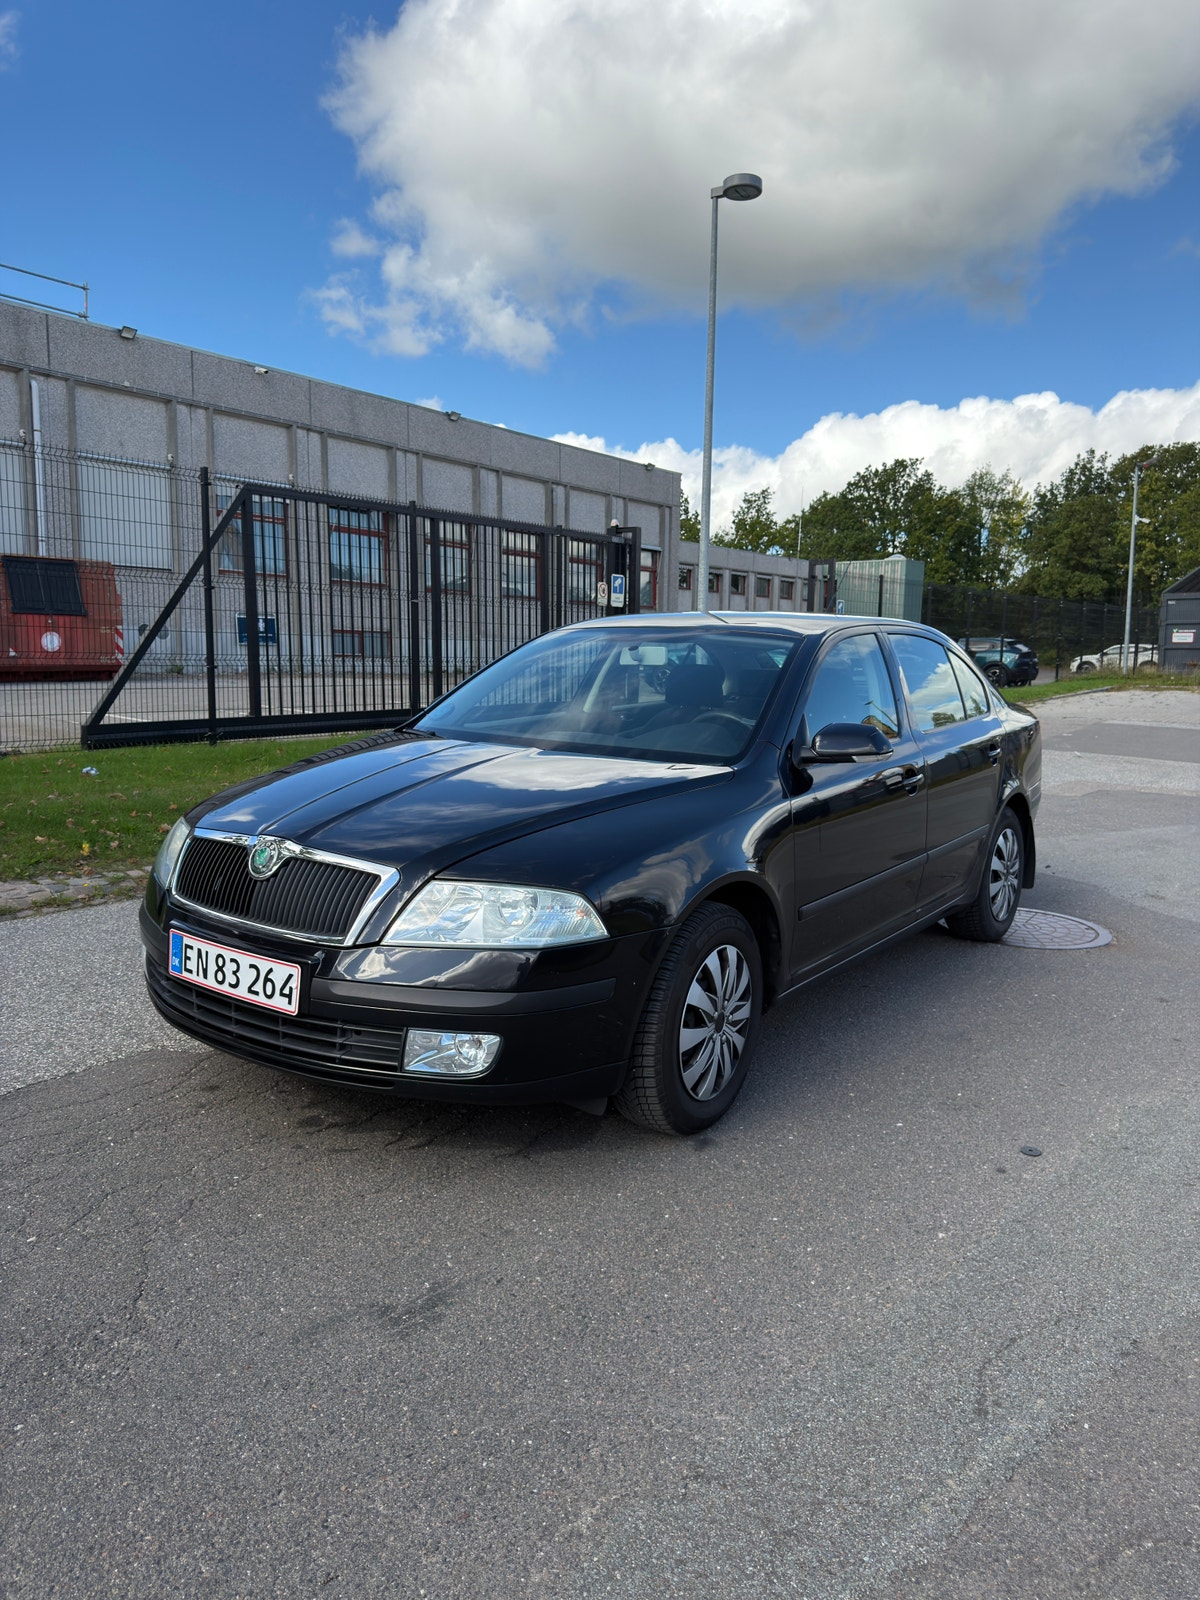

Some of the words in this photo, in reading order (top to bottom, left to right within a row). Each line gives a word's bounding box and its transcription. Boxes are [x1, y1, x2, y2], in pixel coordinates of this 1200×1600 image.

[172, 956, 180, 967] DK
[183, 943, 208, 980] EN
[214, 953, 240, 989] 83
[247, 963, 294, 1006] 264
